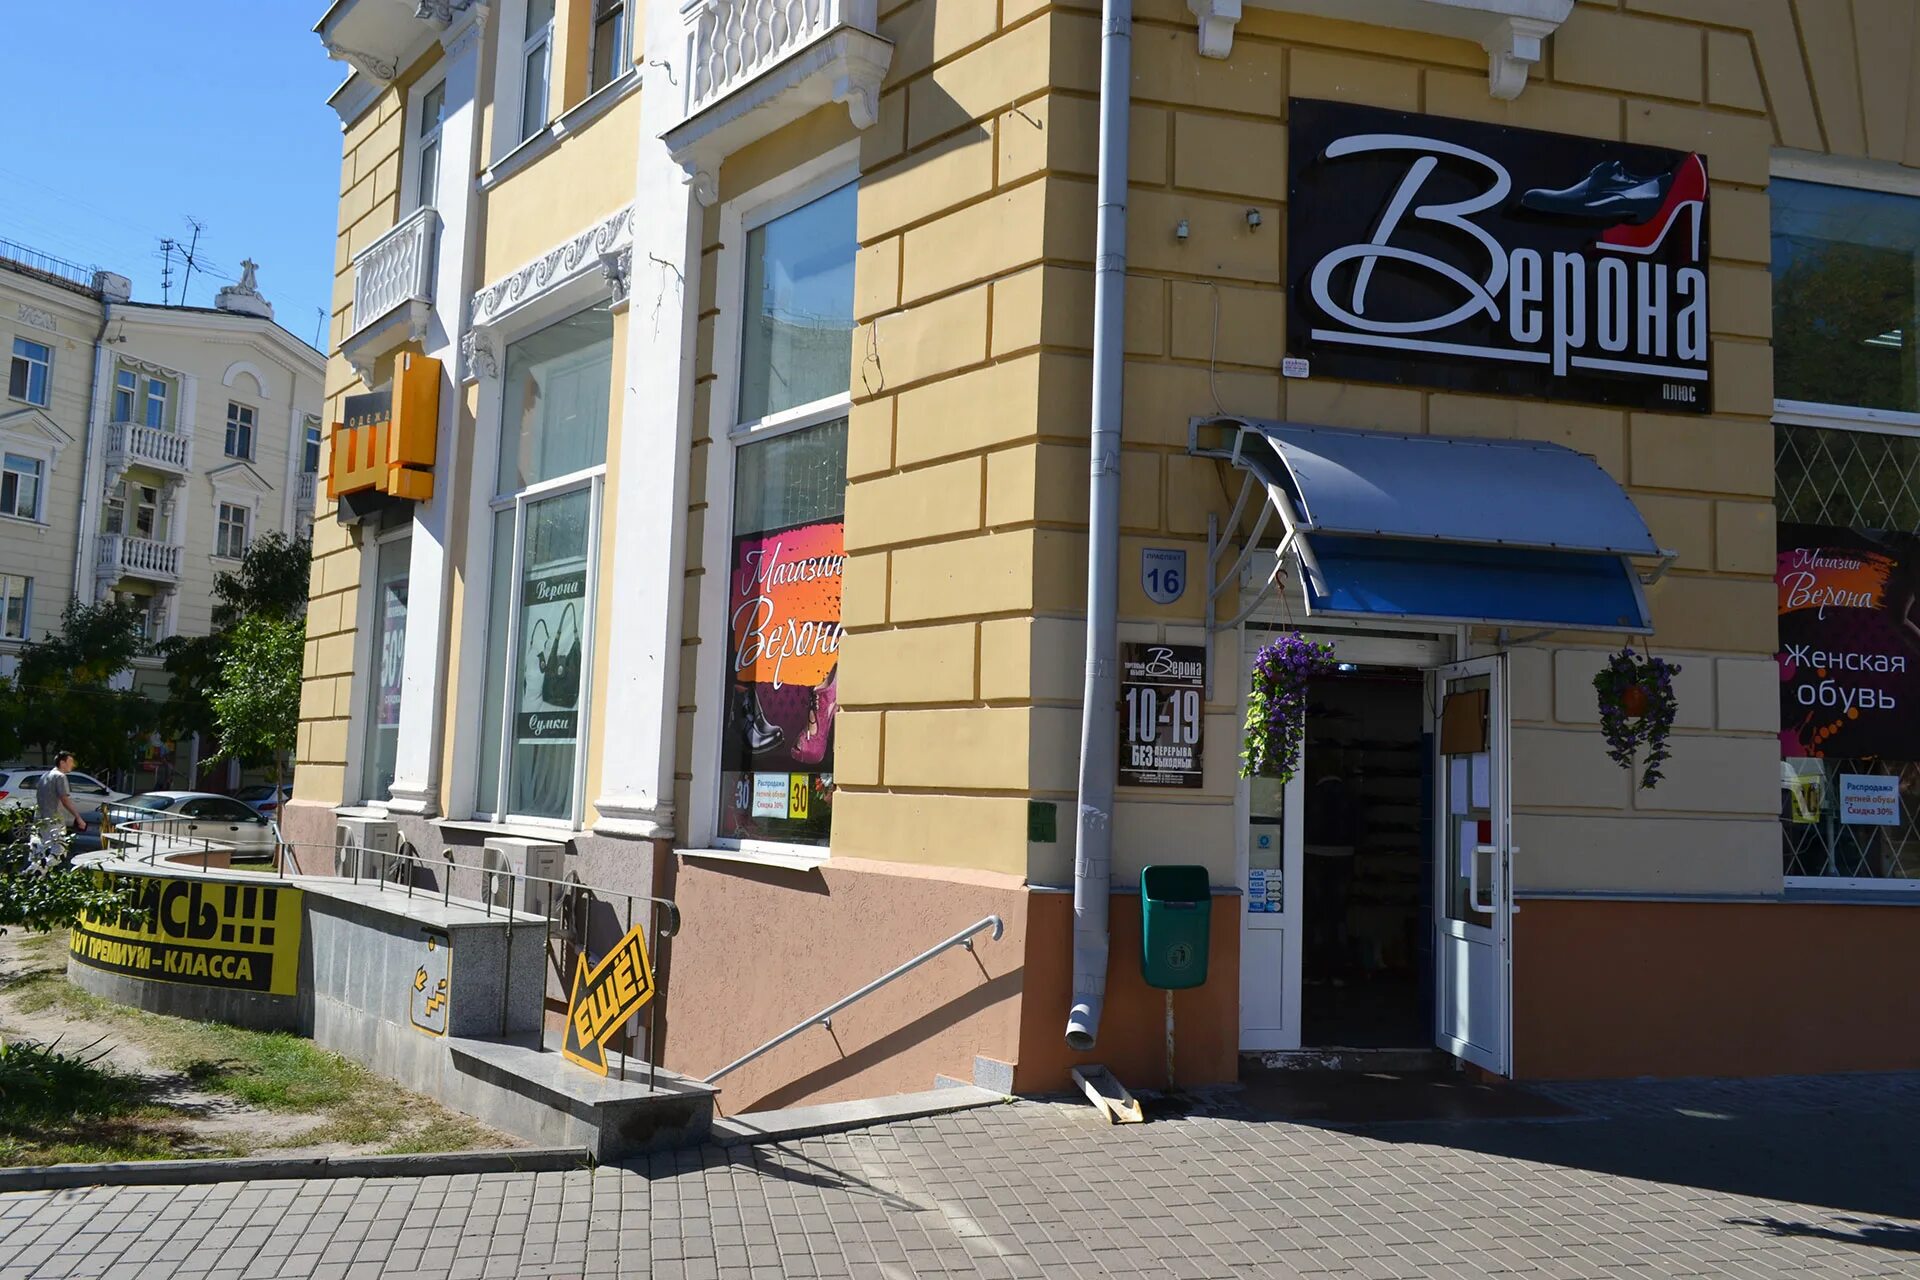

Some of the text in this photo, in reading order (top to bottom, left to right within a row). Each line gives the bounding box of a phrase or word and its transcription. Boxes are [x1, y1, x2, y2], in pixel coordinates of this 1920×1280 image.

[1309, 132, 1709, 377] Верона
[349, 409, 390, 427] ОДЕЖД
[742, 541, 844, 596] Магазин
[1793, 547, 1863, 572] Магазин
[536, 578, 579, 601] Верона
[1147, 568, 1180, 594] 16
[1782, 571, 1873, 621] Верона
[1145, 647, 1202, 679] Верона
[1784, 642, 1906, 673] Женская
[1797, 680, 1896, 713] обувь
[528, 714, 570, 741] Сумки
[1125, 686, 1200, 745] 10-19
[1131, 744, 1193, 767] БЕЗ ПЕРЕРЫВА
[1154, 757, 1193, 769] ВЫХОДНЫХ
[1847, 782, 1893, 793] Распродажа
[1847, 805, 1895, 816] Скидка 30%
[573, 940, 647, 1051] ЕЩЁ!
